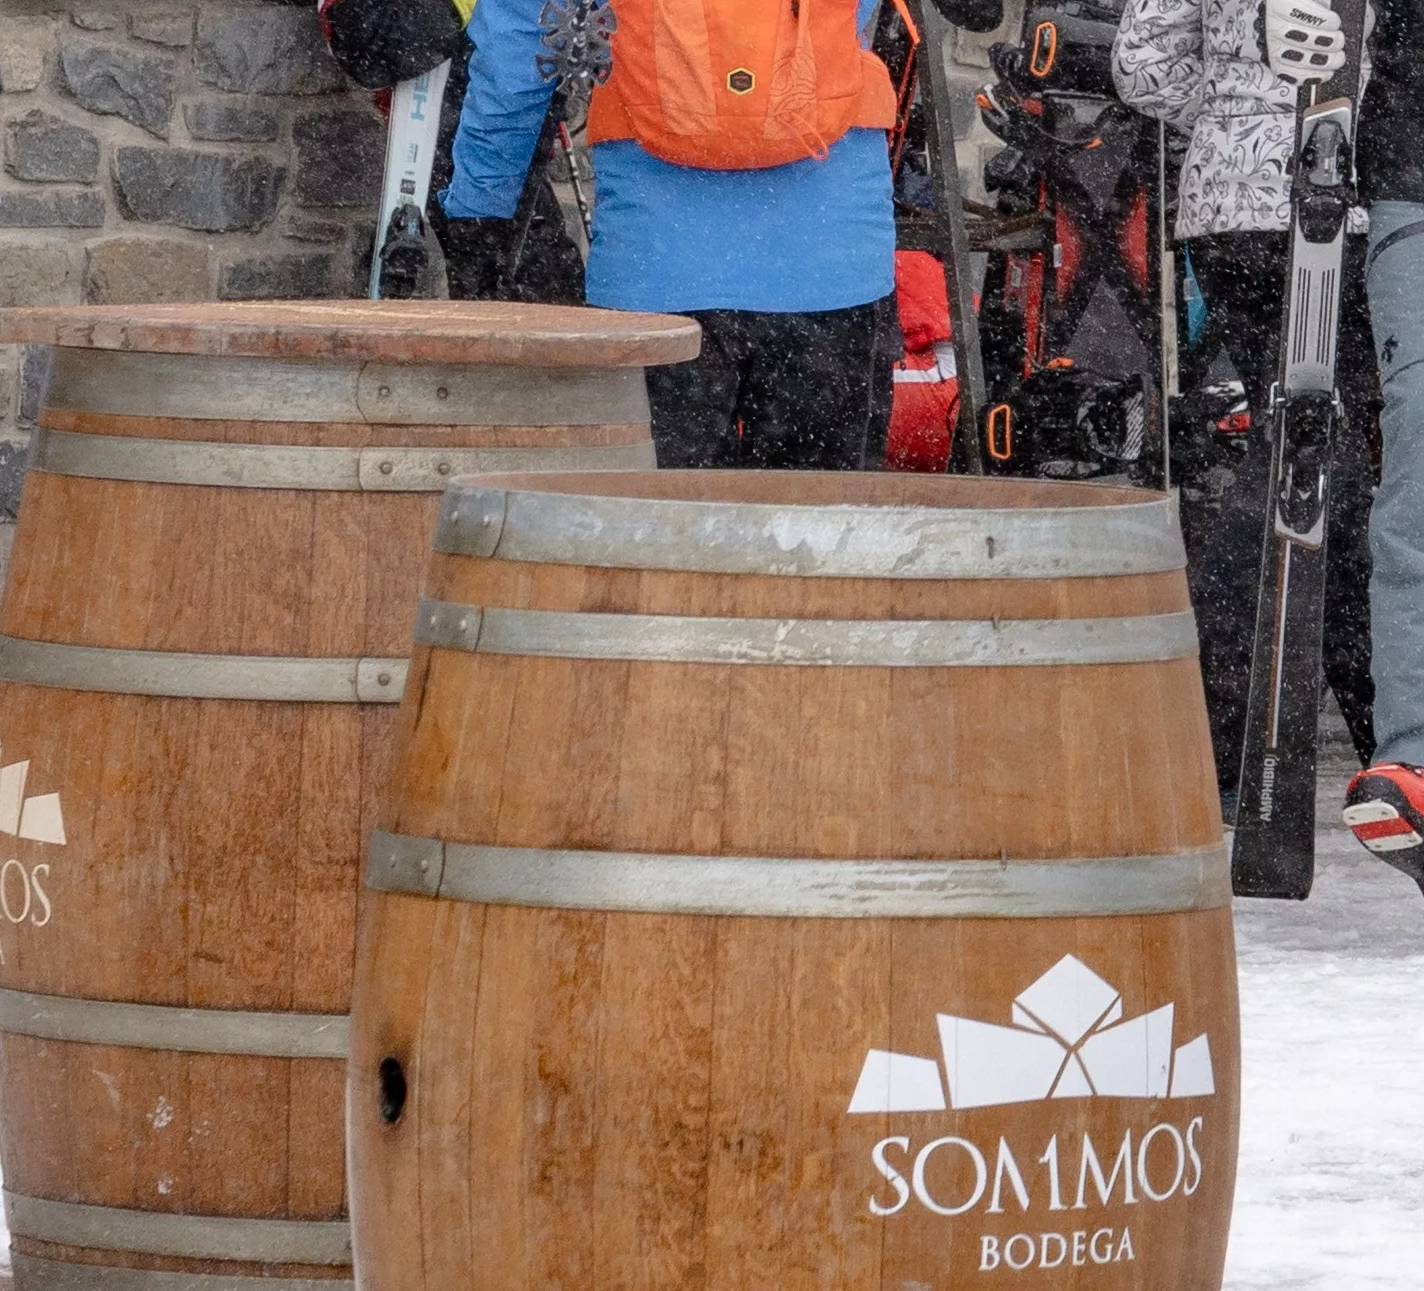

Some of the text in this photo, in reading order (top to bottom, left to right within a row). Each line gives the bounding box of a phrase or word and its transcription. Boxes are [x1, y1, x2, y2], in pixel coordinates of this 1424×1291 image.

[1289, 7, 1328, 27] SWANY
[1258, 758, 1276, 822] AMPHIBIO
[979, 1227, 1136, 1272] BODEGA
